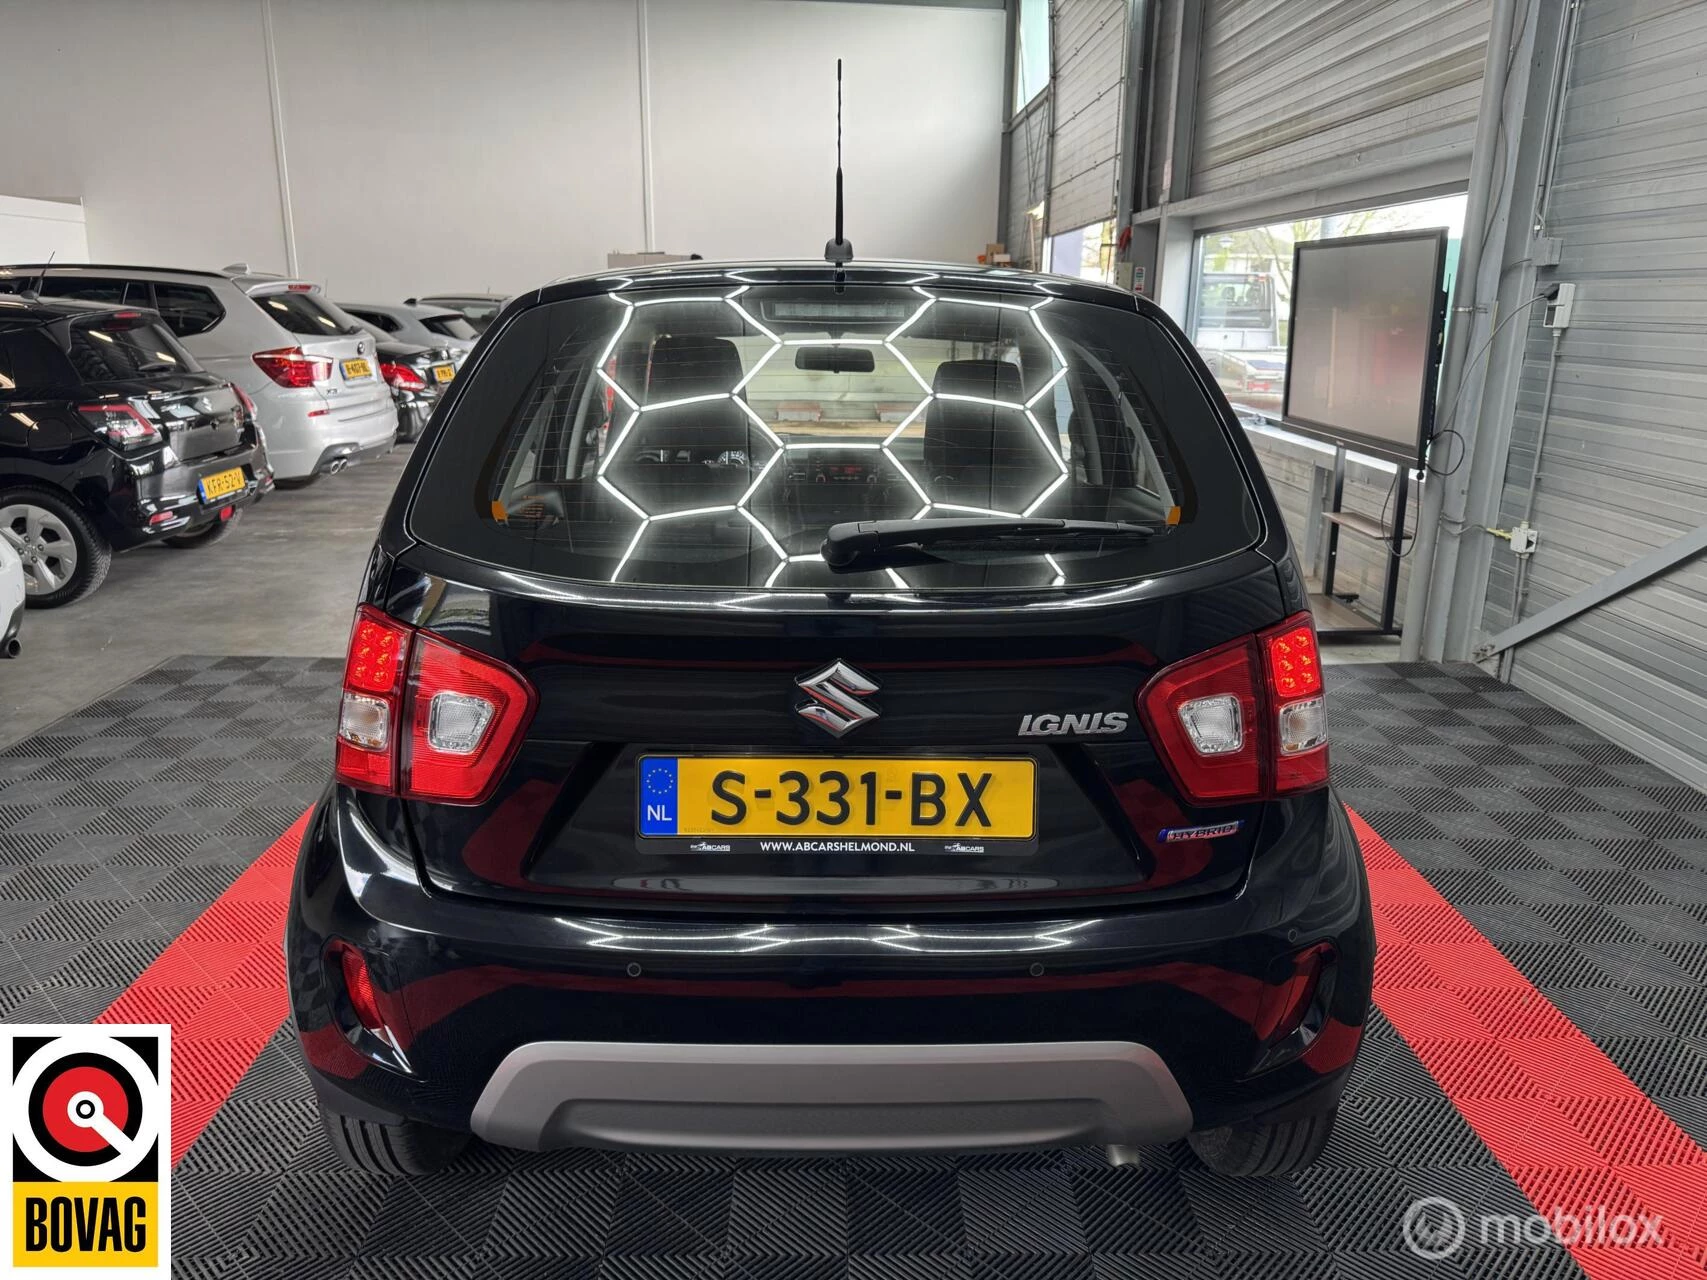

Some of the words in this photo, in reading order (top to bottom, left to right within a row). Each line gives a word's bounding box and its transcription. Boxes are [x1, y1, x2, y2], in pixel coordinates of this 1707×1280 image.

[1018, 712, 1129, 736] IGNIS
[710, 771, 993, 827] S-331-BX
[647, 804, 673, 821] NL
[1173, 825, 1229, 838] HYBRID
[760, 841, 916, 853] WWW.ABCARSHELMOND.NL
